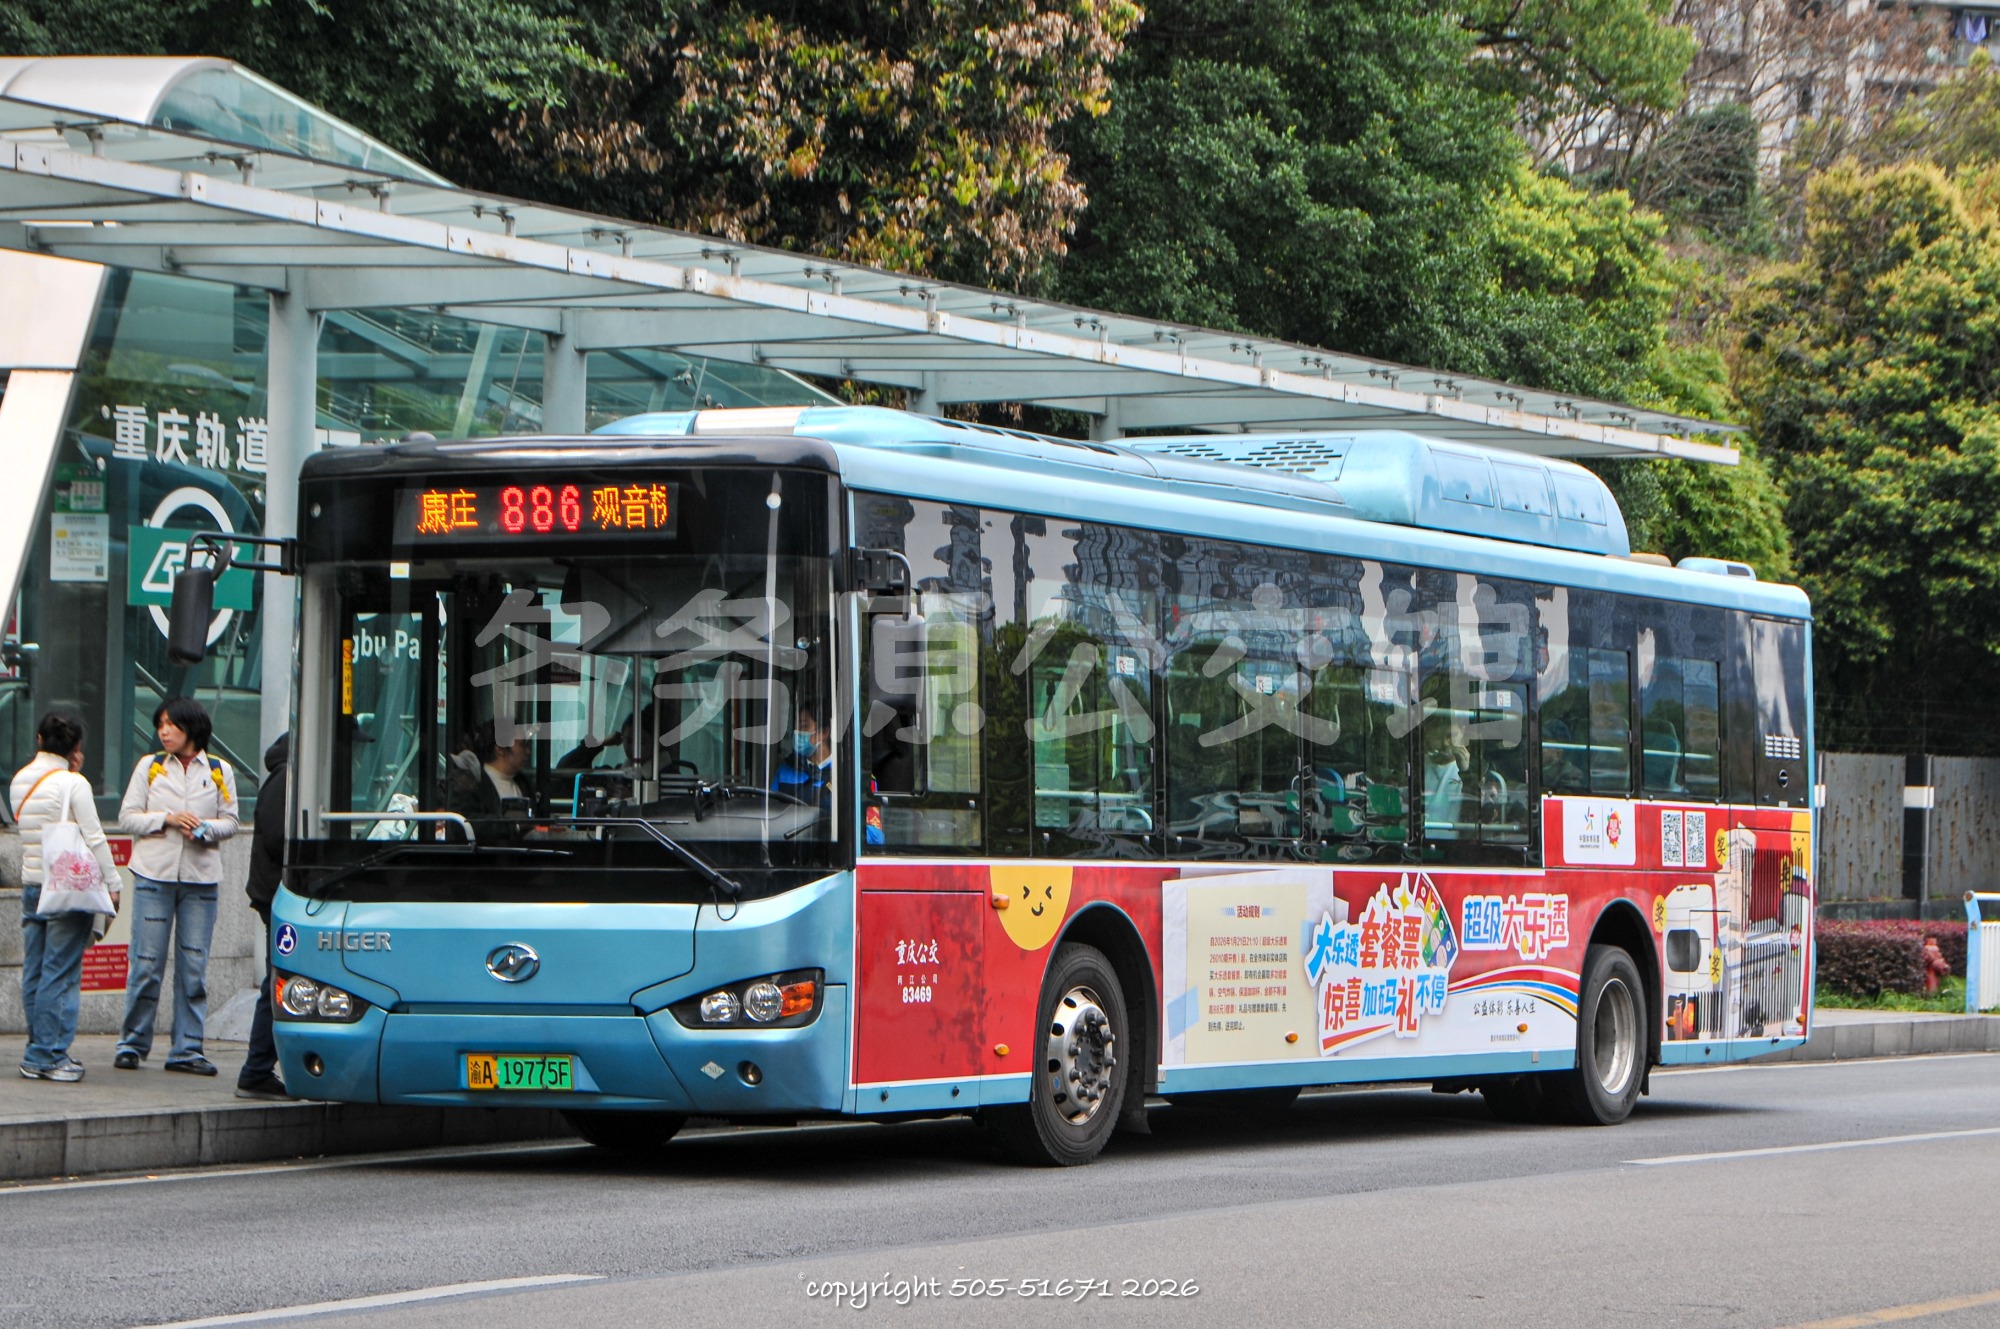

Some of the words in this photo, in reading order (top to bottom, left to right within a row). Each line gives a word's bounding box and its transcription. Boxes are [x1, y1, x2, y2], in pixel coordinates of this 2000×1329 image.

[112, 404, 267, 473] 重庆轨道
[417, 489, 478, 534] 康庄
[502, 485, 582, 533] 886
[317, 931, 392, 952] HIGER
[1308, 906, 1423, 980] 大乐透套餐票
[1463, 896, 1568, 956] 超级大乐透
[895, 939, 940, 966] 重庆公交
[897, 973, 938, 985] 两江公司
[902, 985, 932, 1004] 83469
[1323, 973, 1446, 1032] 惊喜加码礼不停
